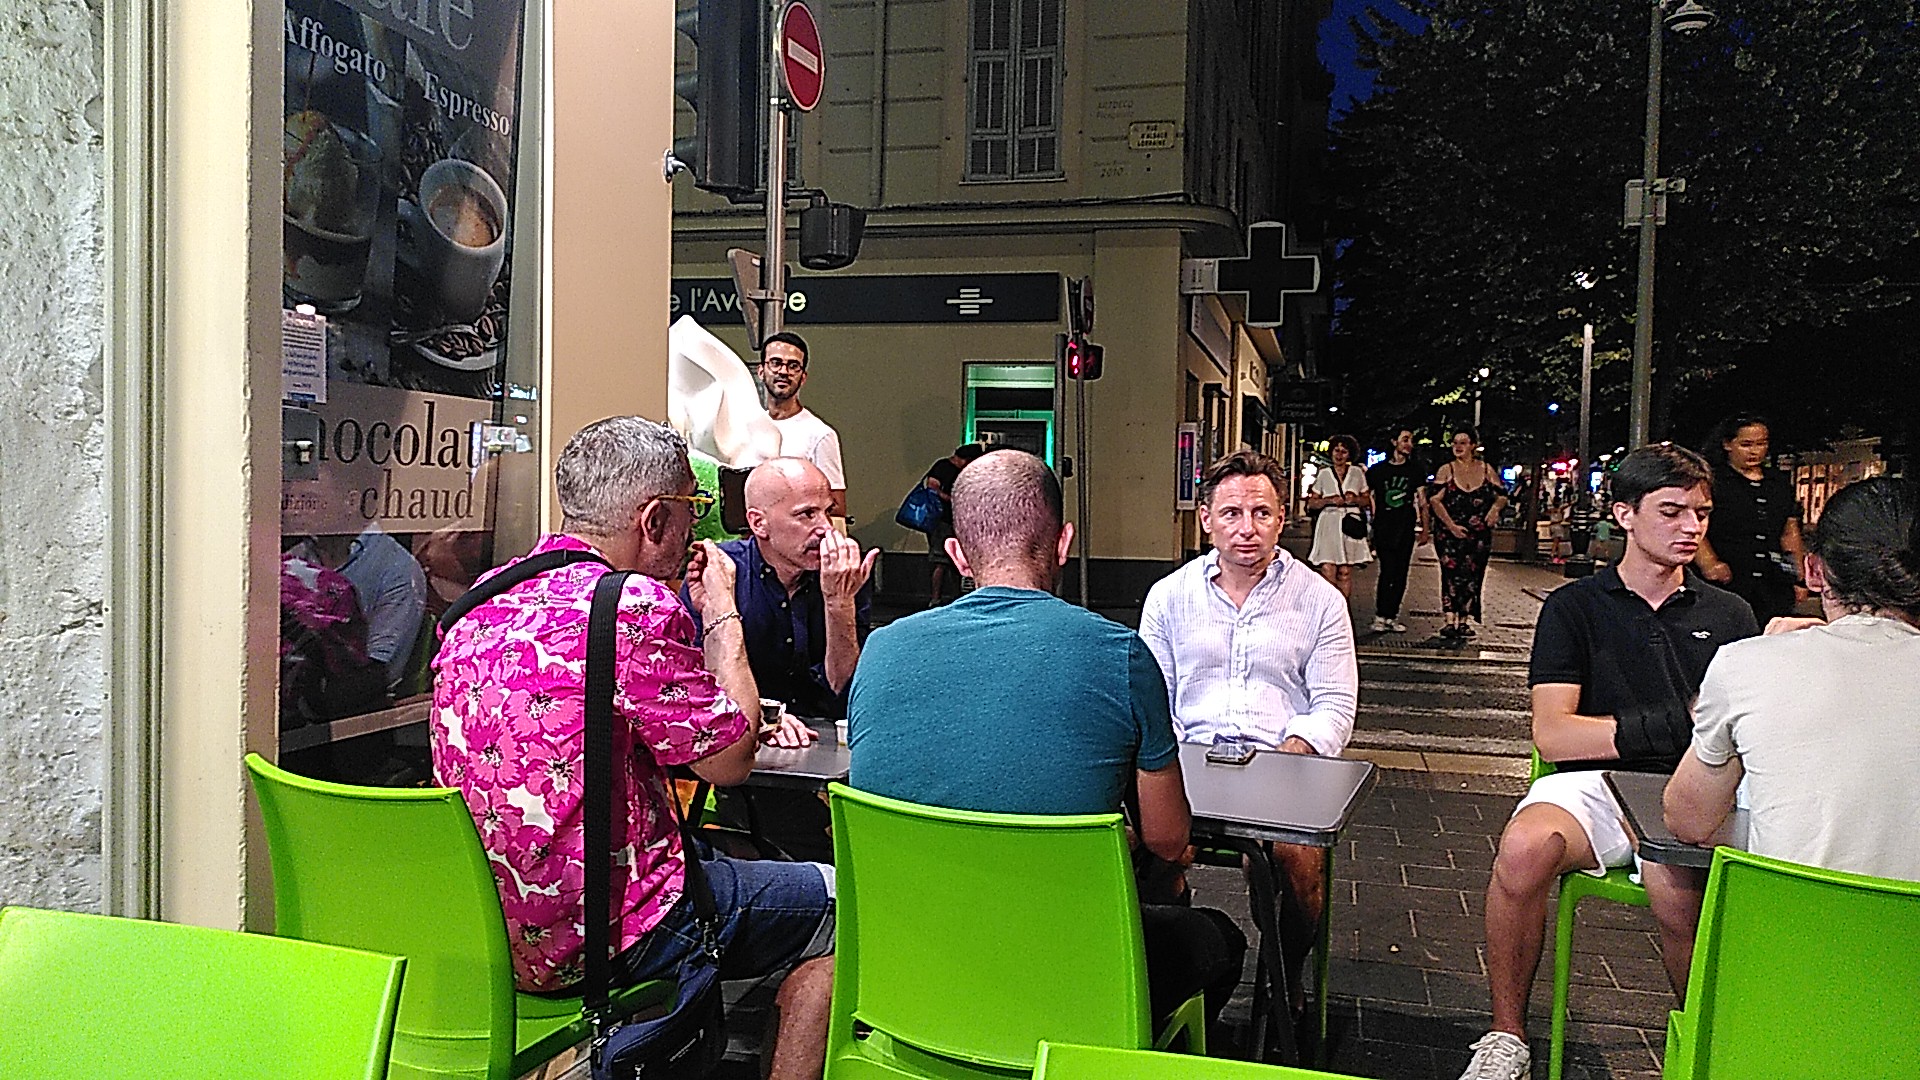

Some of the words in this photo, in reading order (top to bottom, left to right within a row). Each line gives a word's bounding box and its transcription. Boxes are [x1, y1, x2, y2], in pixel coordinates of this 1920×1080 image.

[285, 9, 387, 82] Affogato
[423, 71, 510, 136] Espresso
[690, 288, 807, 312] l'Ave
[359, 468, 474, 519] chaud
